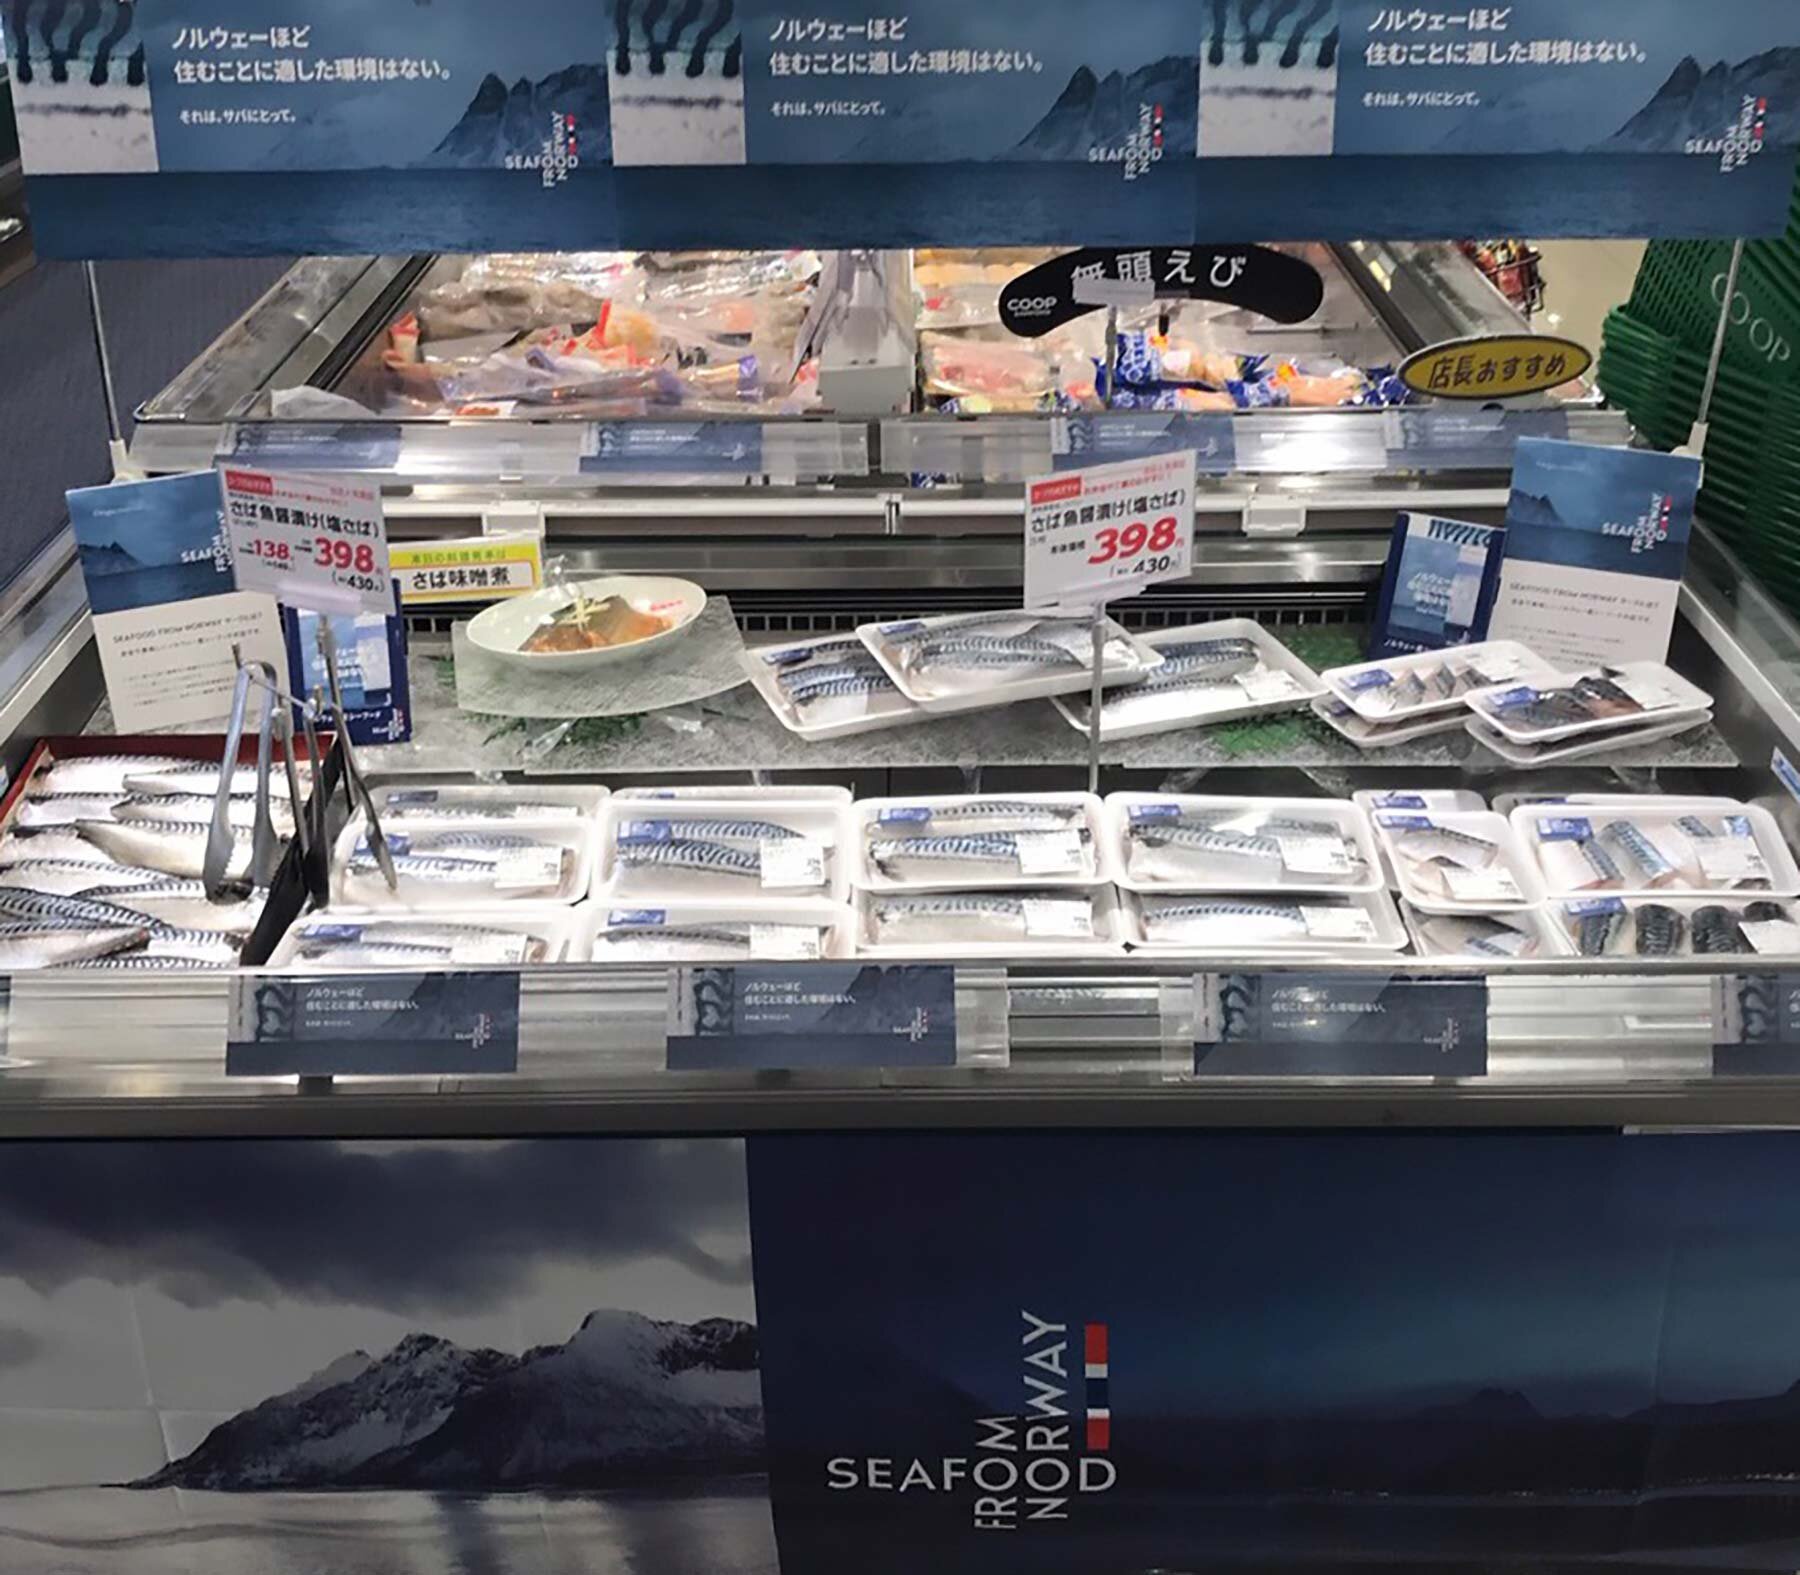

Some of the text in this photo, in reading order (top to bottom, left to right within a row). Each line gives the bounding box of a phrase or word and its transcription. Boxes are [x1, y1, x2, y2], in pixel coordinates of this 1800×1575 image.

[770, 17, 908, 41] ノルウェーほど
[1368, 8, 1511, 32] ノルウェーほど
[172, 26, 310, 49] ノルウェーほど
[769, 51, 1043, 76] 住むことに適した環境はない。
[1365, 41, 1648, 66] 住むことに適した環境はない。
[174, 59, 450, 83] 住むことに適した環境はない。
[1088, 147, 1163, 163] SEAFOOD
[1684, 138, 1763, 155] SEAFOOD
[504, 155, 579, 170] SEAFOOD
[1007, 296, 1058, 311] COOP
[1428, 352, 1567, 388] 店長おすすめ
[1087, 516, 1177, 565] 398
[254, 539, 290, 560] 138
[313, 537, 375, 574] 398
[1021, 1309, 1071, 1520] NORWAY
[826, 1457, 1118, 1493] SEAFOOD
[973, 1415, 1019, 1530] FROM
